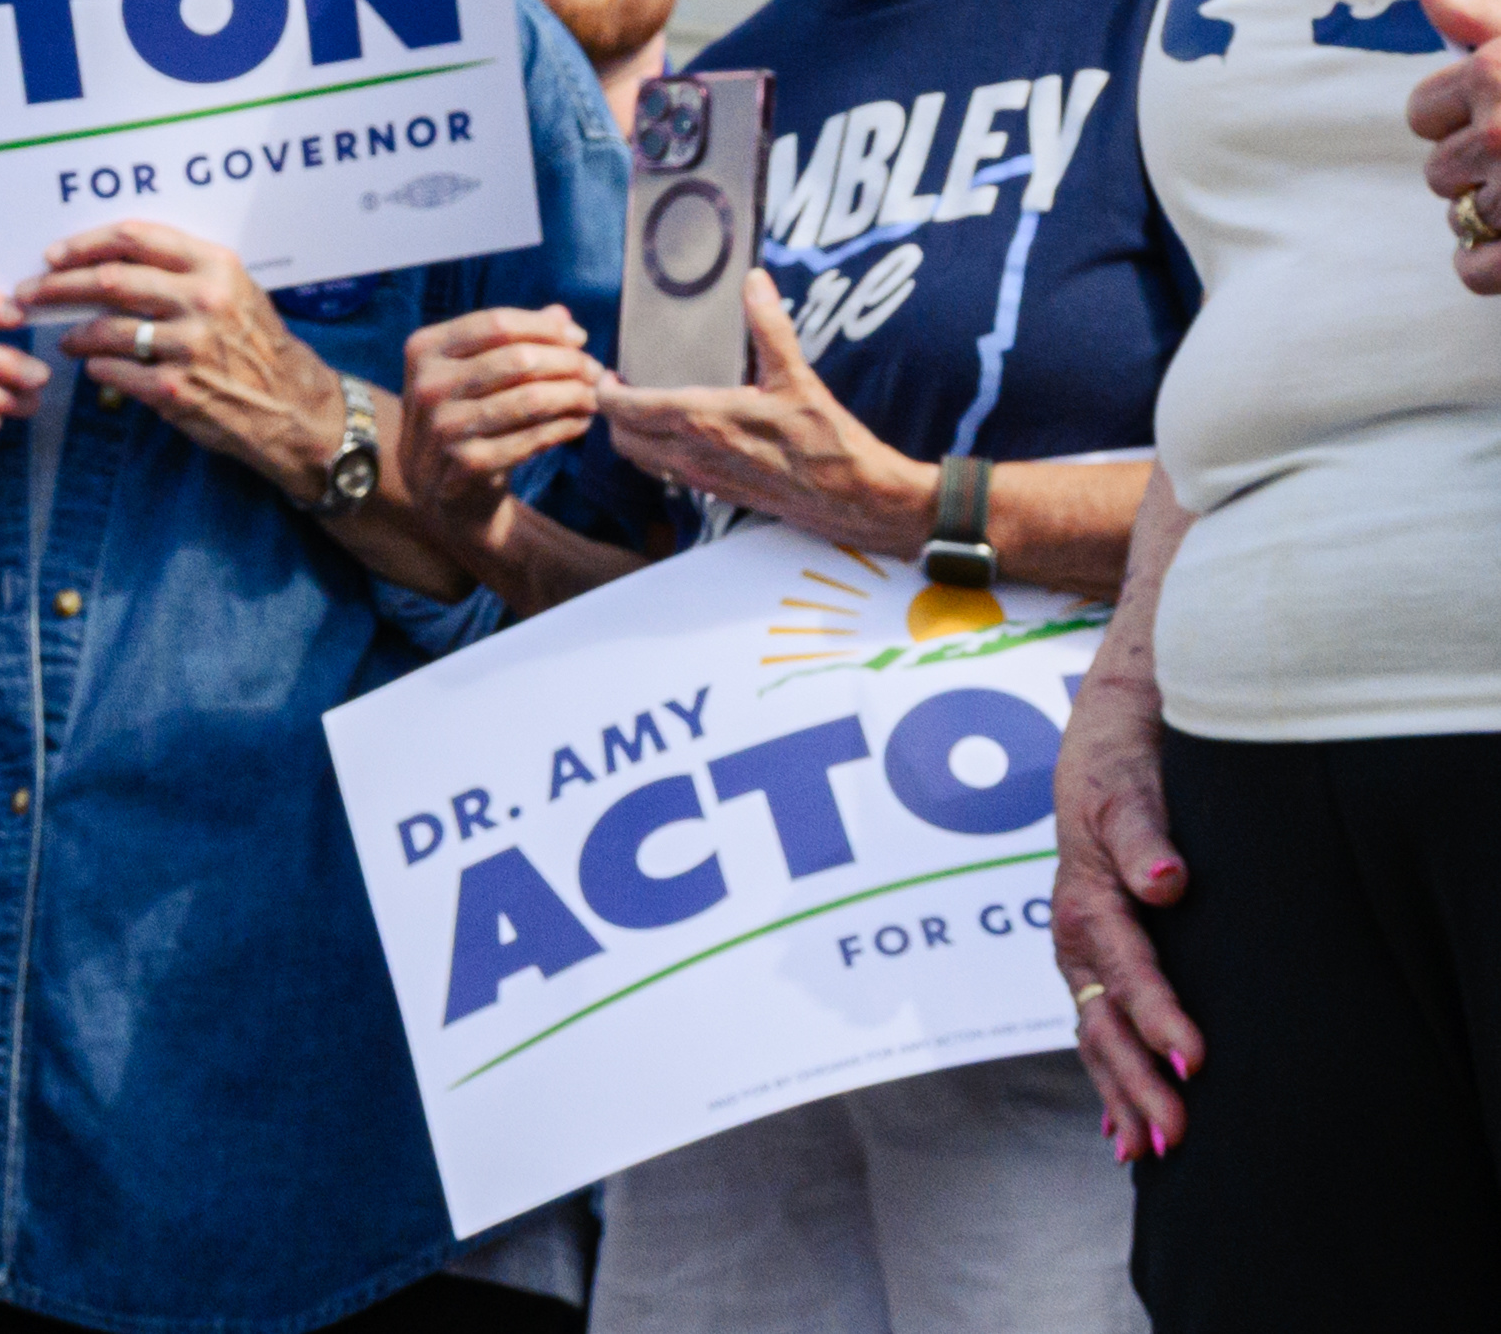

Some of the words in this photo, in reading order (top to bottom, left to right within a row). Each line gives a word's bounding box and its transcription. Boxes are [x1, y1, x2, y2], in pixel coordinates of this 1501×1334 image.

[59, 164, 156, 203] FOR
[186, 108, 476, 186] GOVERNOR
[396, 806, 522, 866] DR.
[549, 686, 709, 802] AMY
[443, 673, 1085, 1029] ACTO
[837, 916, 952, 968] FOR
